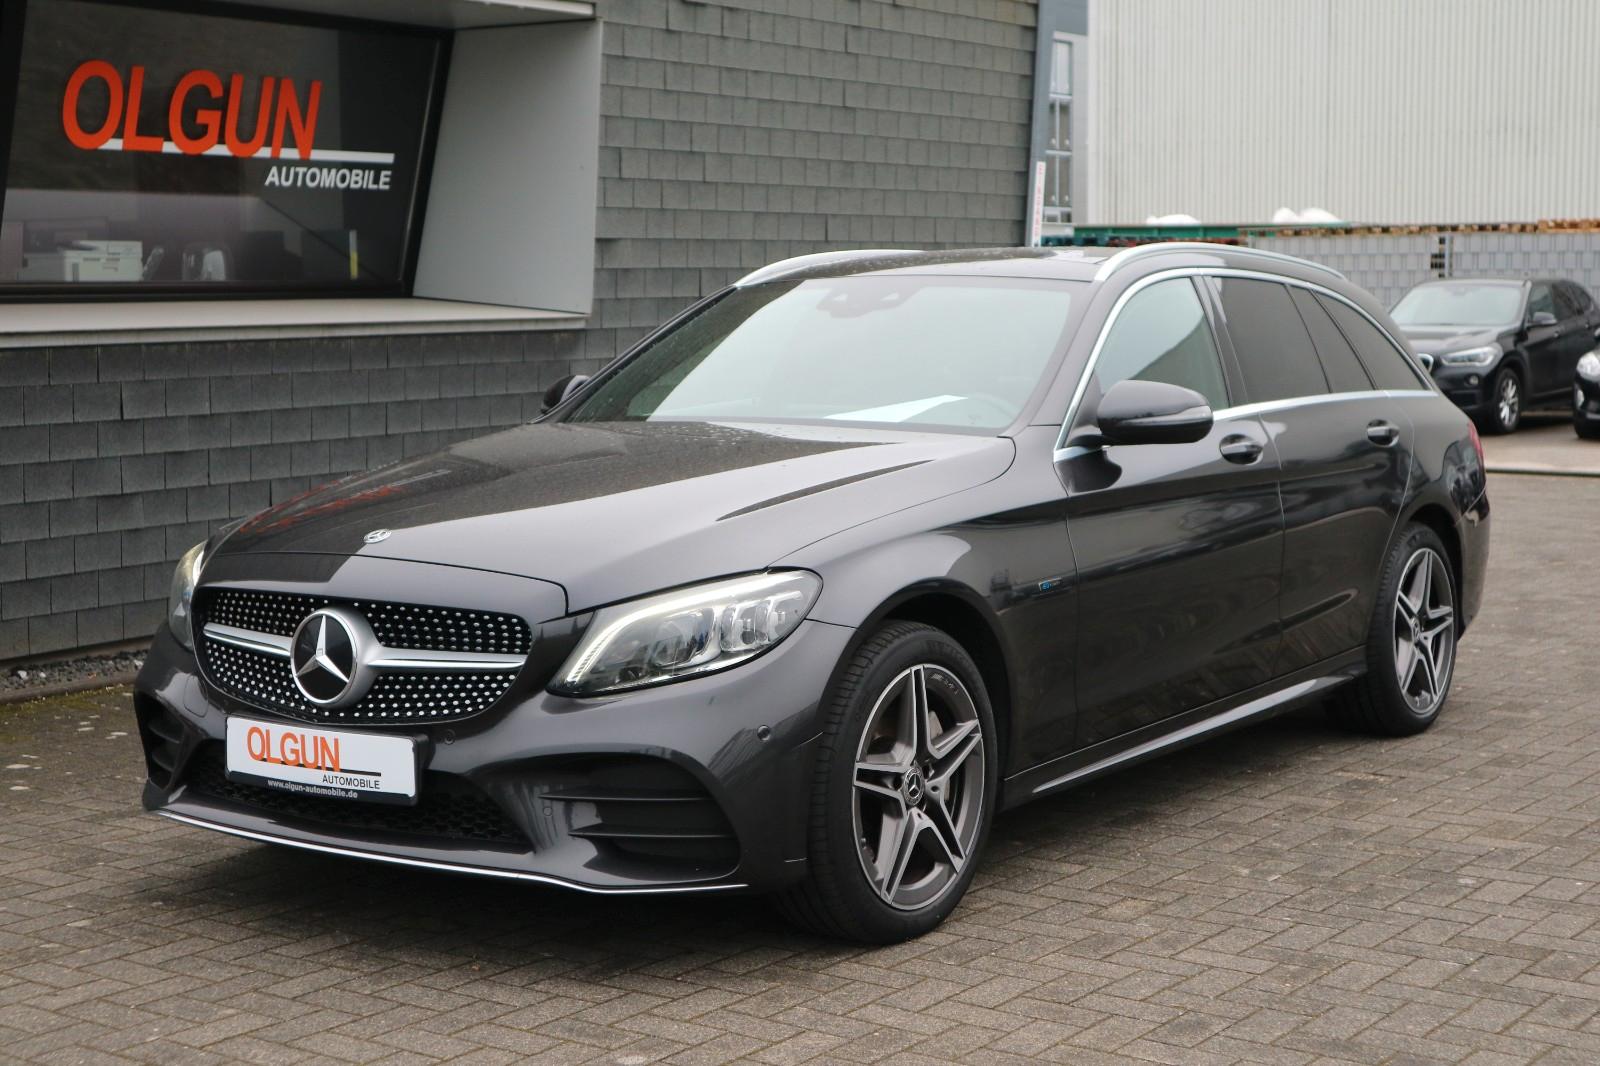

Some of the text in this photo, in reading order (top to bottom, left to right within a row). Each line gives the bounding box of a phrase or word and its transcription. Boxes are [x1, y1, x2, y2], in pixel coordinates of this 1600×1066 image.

[62, 59, 322, 160] OLGUN
[265, 166, 391, 190] AUTOMOBILE
[247, 726, 341, 772] OLGUN
[267, 779, 358, 799] www.olgun-automobile.de
[322, 774, 381, 789] AUTOMOBILE
